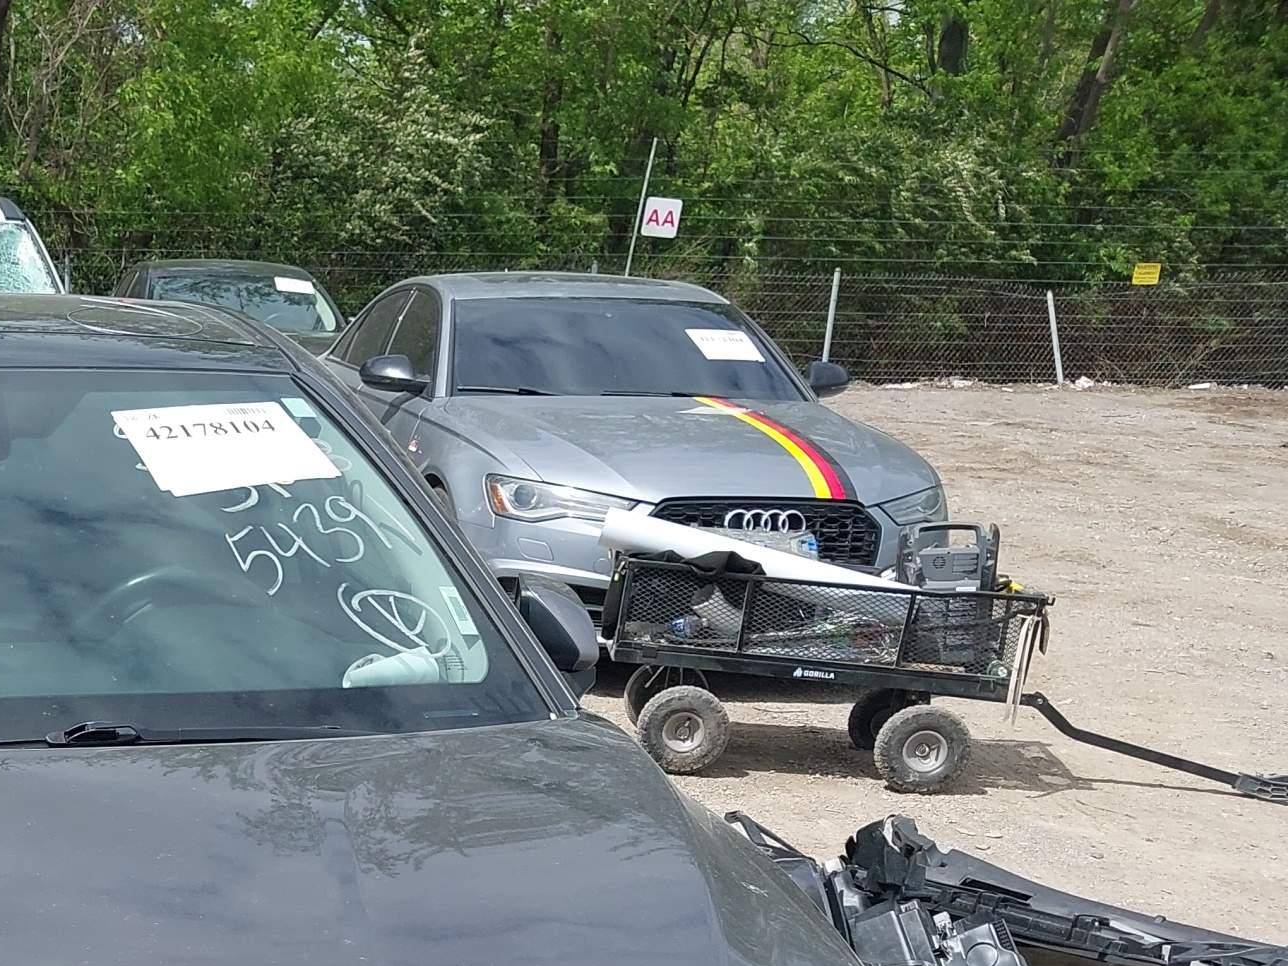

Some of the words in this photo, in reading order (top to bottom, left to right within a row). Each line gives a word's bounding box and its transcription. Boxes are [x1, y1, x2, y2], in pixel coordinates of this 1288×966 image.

[646, 208, 675, 228] AA
[145, 419, 276, 440] 42178104
[803, 670, 835, 680] GORILLA
